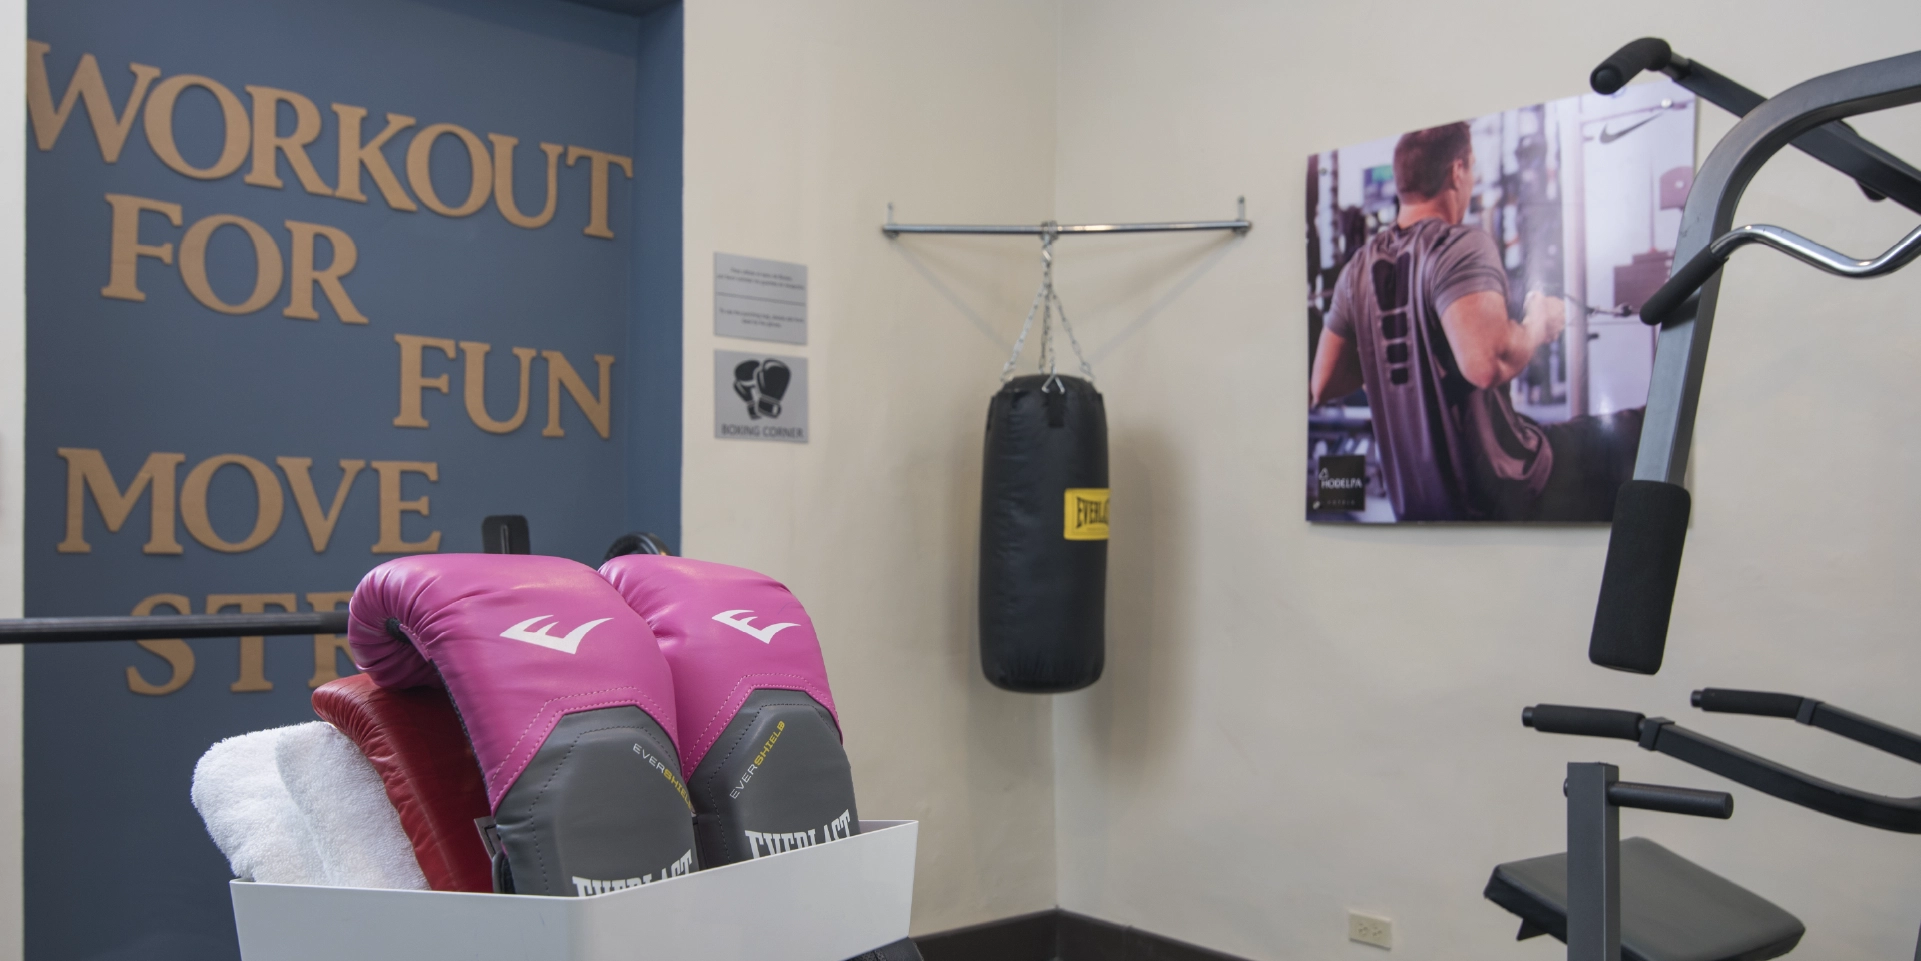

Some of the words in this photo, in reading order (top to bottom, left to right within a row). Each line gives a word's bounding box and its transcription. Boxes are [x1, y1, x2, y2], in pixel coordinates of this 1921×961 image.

[26, 39, 633, 239] WORKOUT
[101, 192, 369, 324] FOR
[393, 333, 615, 439] FUN
[721, 423, 760, 436] BOXING
[762, 426, 804, 437] CORNER
[56, 446, 442, 555] MOVE
[1320, 477, 1363, 489] HODELPA
